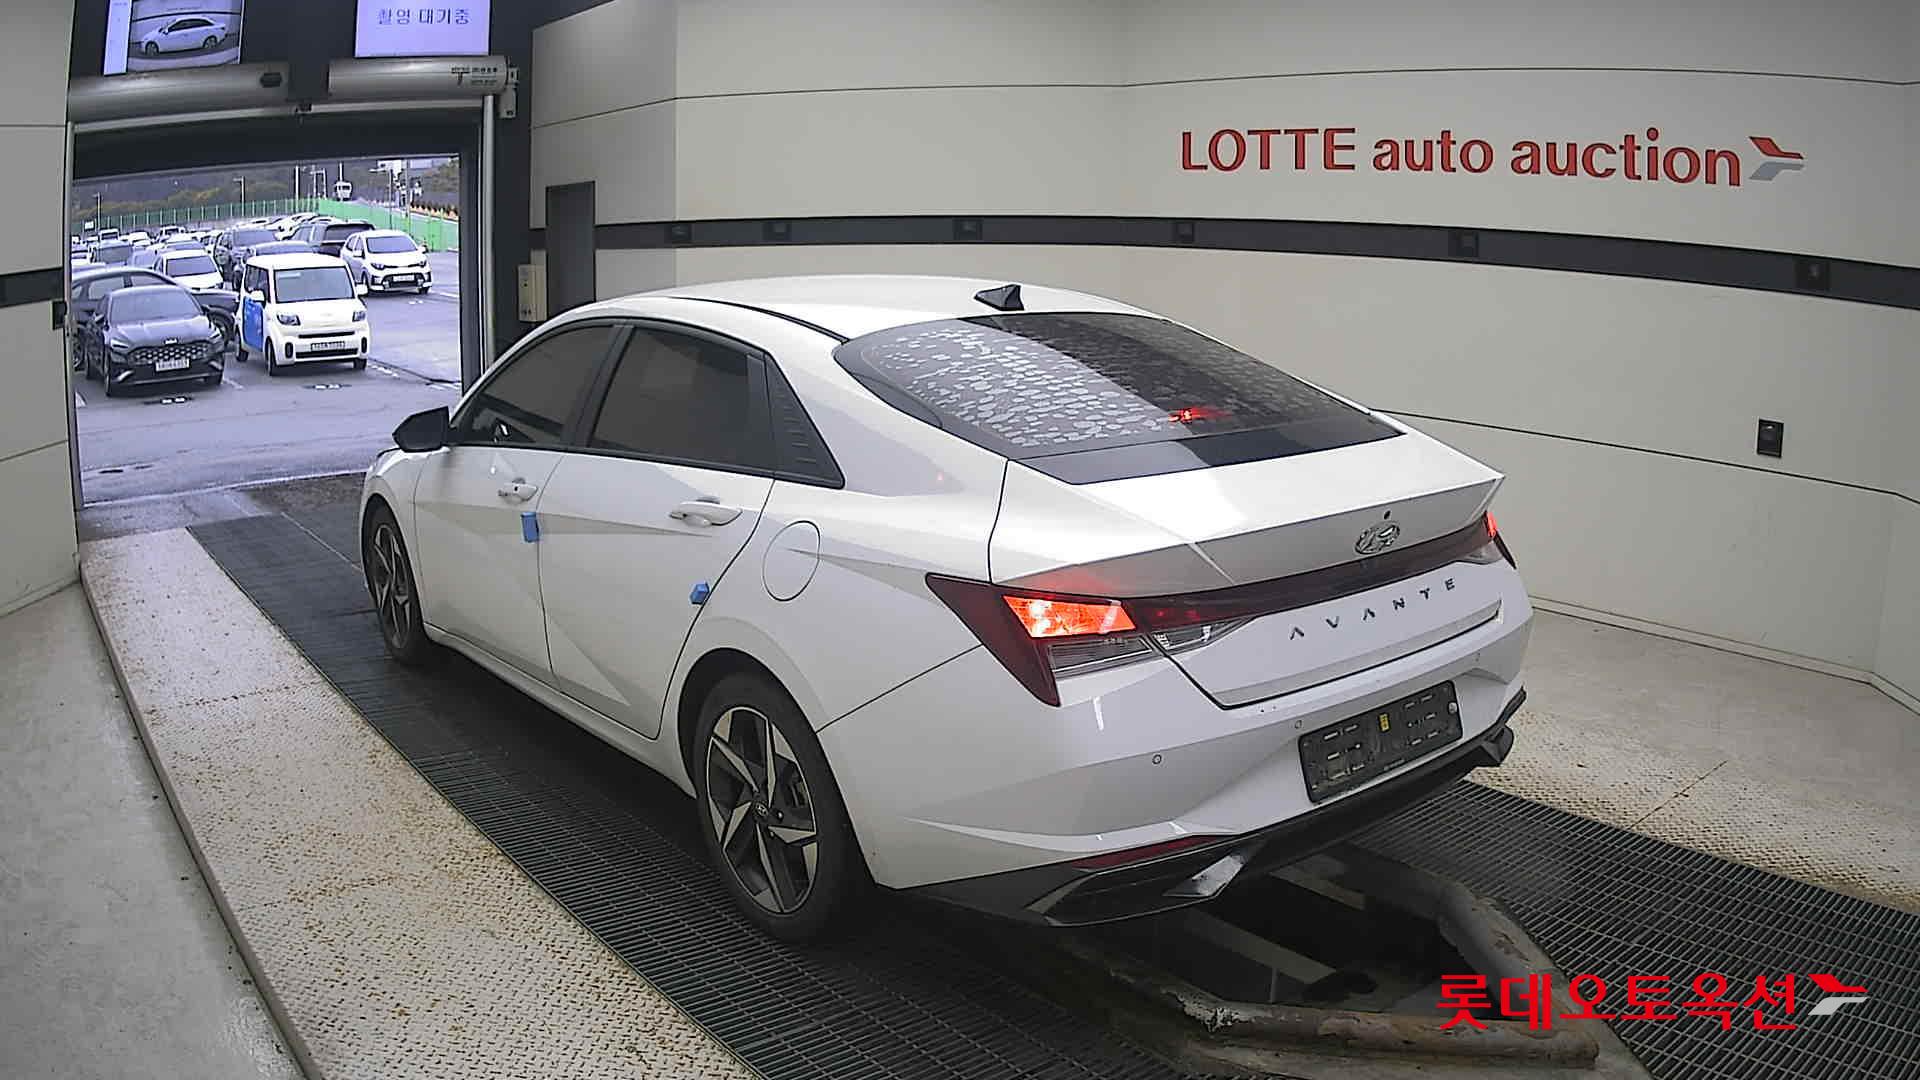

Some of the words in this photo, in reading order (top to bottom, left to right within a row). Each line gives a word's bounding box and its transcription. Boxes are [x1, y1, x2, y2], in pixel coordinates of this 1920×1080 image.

[418, 8, 471, 25] 대기중
[1182, 128, 1356, 171] LOTTE
[1372, 130, 1494, 174] auto
[1510, 127, 1742, 187] auction
[1289, 578, 1455, 640] AVANTE
